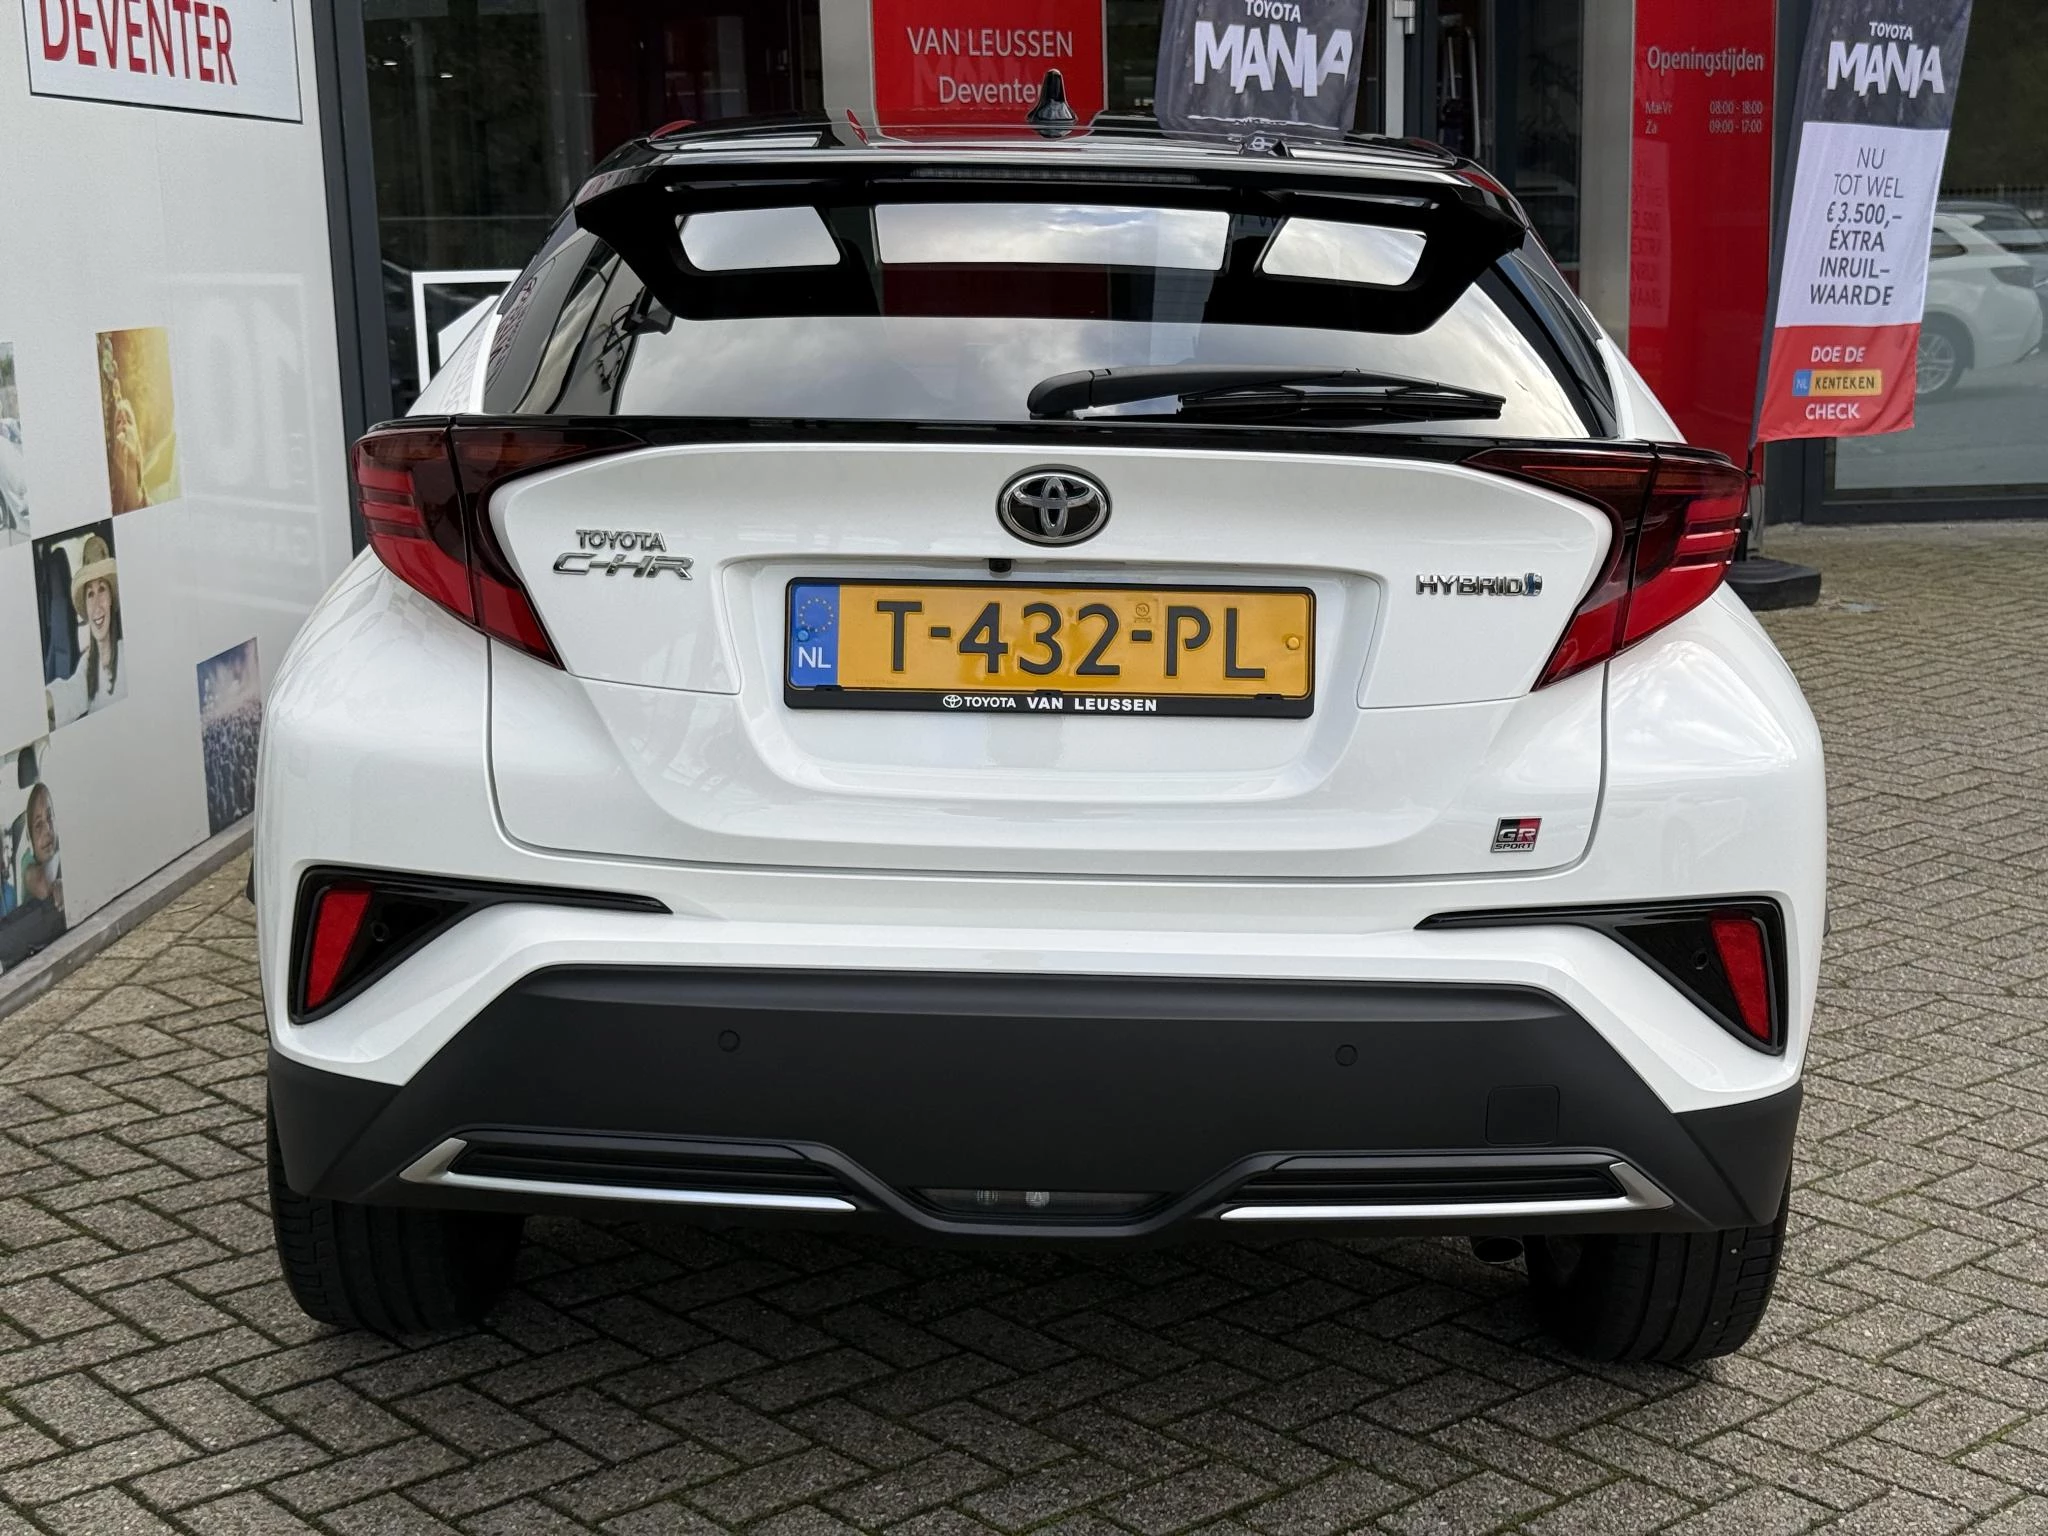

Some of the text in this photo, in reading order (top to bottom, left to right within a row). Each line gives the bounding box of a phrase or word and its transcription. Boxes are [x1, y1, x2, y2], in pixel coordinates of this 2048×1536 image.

[1244, 0, 1302, 23] TOYOTA
[906, 26, 1074, 58] VAN LEUSSEN
[1869, 21, 1914, 41] TOYOTA
[38, 0, 238, 86] DEVENTER
[1194, 20, 1354, 97] MANIA
[1647, 46, 1765, 77] Openingstijden
[1826, 40, 1945, 98] MANIA
[1645, 119, 1658, 134] Za
[1857, 147, 1885, 169] NU
[1833, 173, 1904, 198] TOT WEL
[1829, 224, 1885, 252] ÉXTRA
[1810, 284, 1894, 306] WAARDE
[1811, 346, 1866, 363] DOE DE
[1814, 373, 1875, 390] KENTEKEN
[1805, 403, 1861, 420] CHECK
[576, 529, 667, 552] TOYOTA
[553, 552, 694, 580] C-HR
[1416, 574, 1523, 597] HYBRID
[797, 645, 832, 669] NL
[876, 600, 1267, 680] T-432-PL
[965, 695, 1158, 712] TOYOTA VAN LEUSSEN
[1494, 842, 1533, 850] SPORT
[1498, 828, 1537, 842] GR
